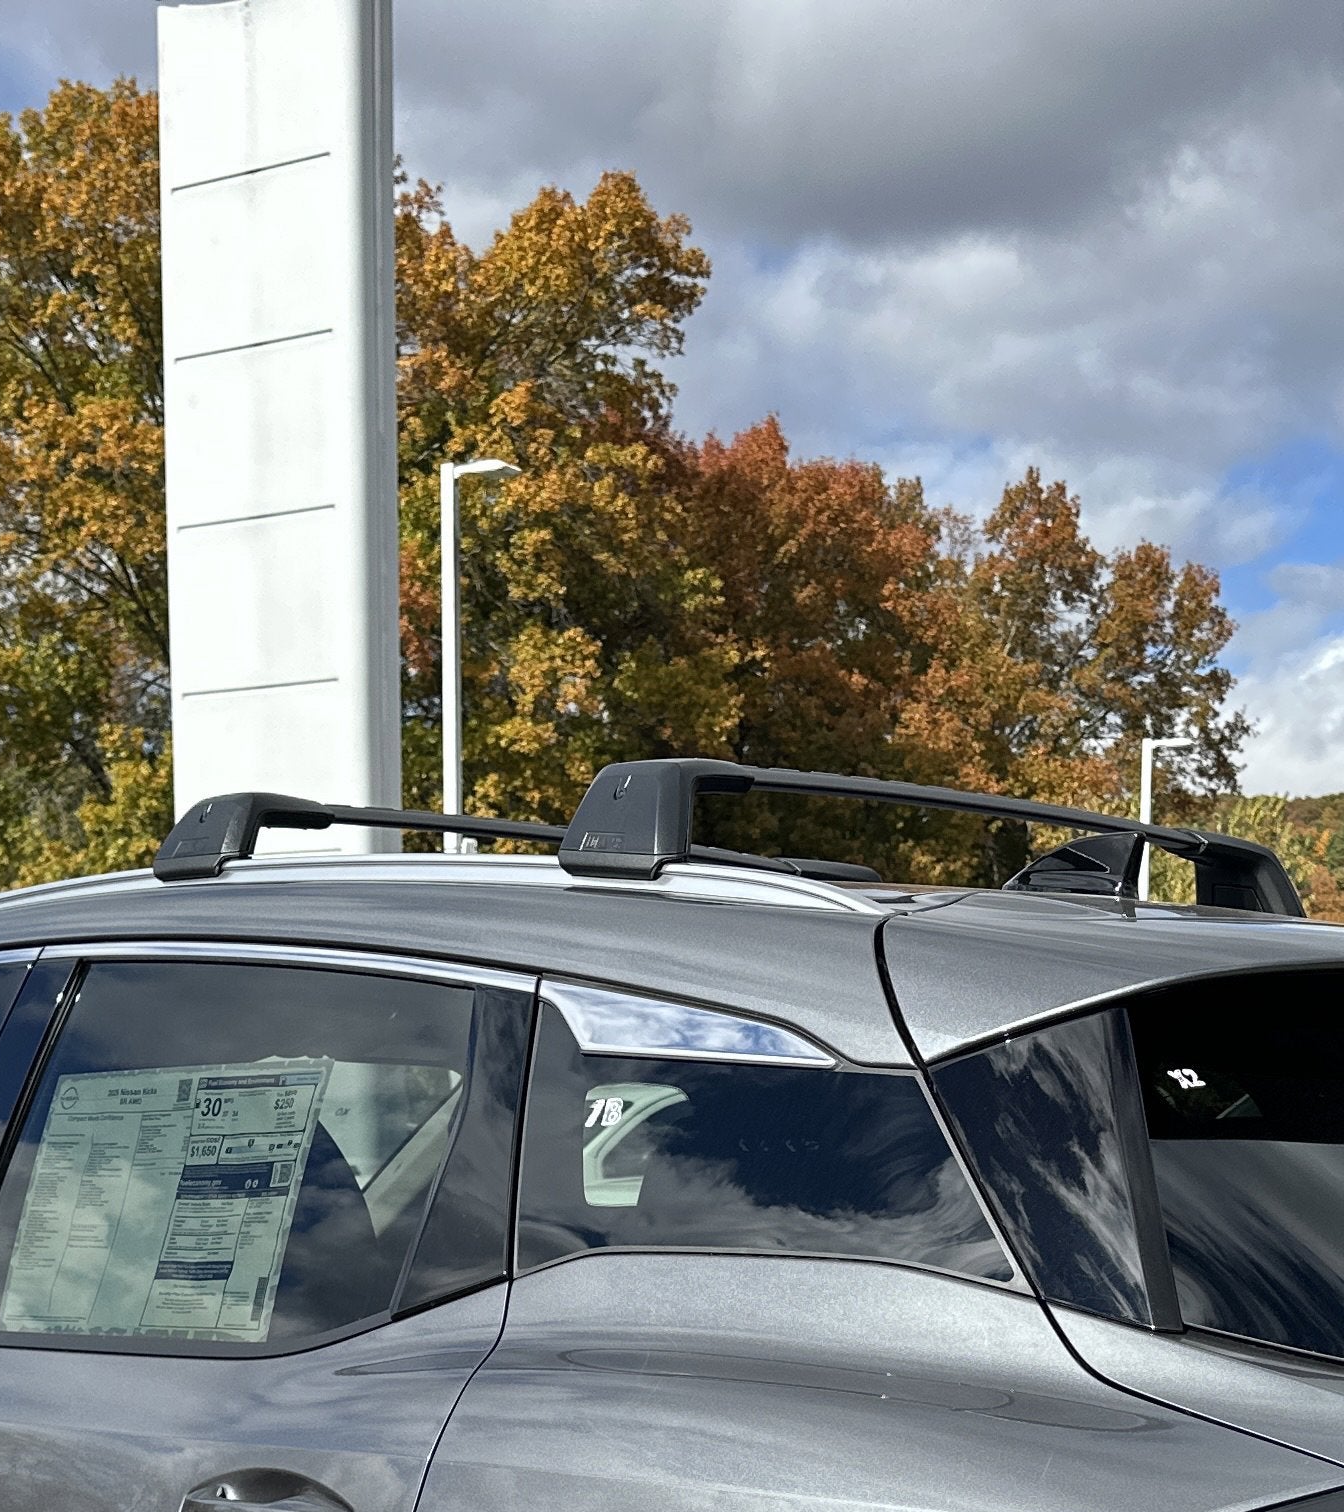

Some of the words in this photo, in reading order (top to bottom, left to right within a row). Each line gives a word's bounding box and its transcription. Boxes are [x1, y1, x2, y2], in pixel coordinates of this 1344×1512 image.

[201, 1097, 222, 1117] 30
[273, 1097, 294, 1110] $250
[190, 1145, 217, 1158] $1,650
